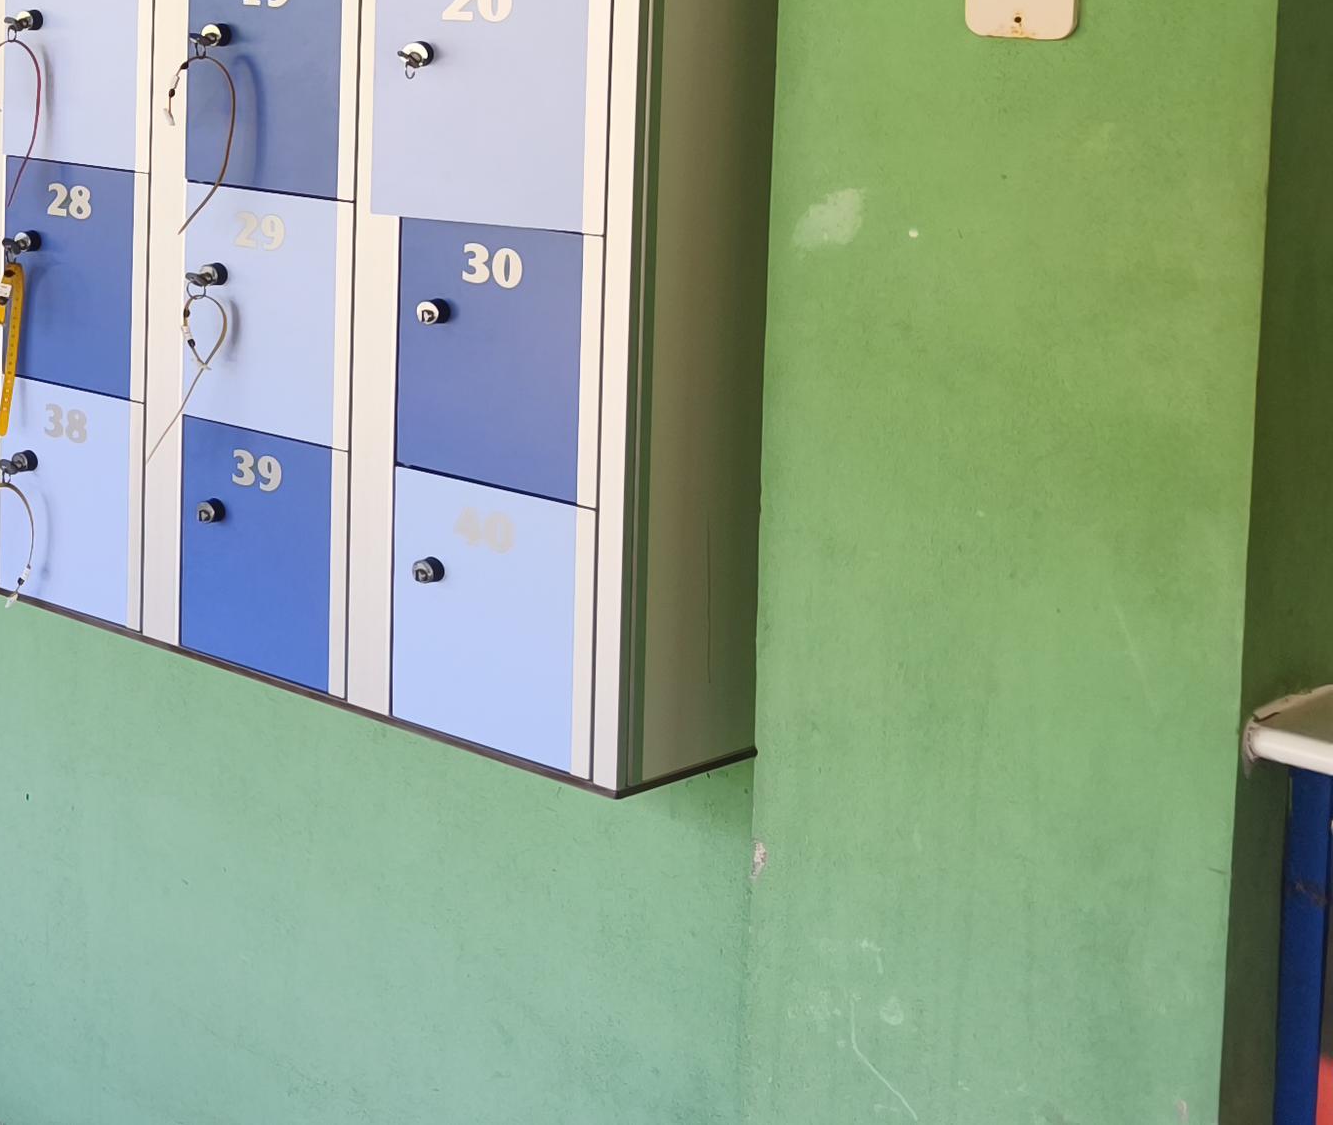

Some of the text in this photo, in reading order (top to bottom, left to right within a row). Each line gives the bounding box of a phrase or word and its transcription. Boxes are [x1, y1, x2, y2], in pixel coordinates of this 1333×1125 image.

[47, 182, 92, 220] 28
[235, 211, 285, 251] 29
[462, 242, 523, 290] 30
[44, 403, 87, 444] 38
[231, 449, 282, 492] 39
[454, 506, 515, 554] 40
